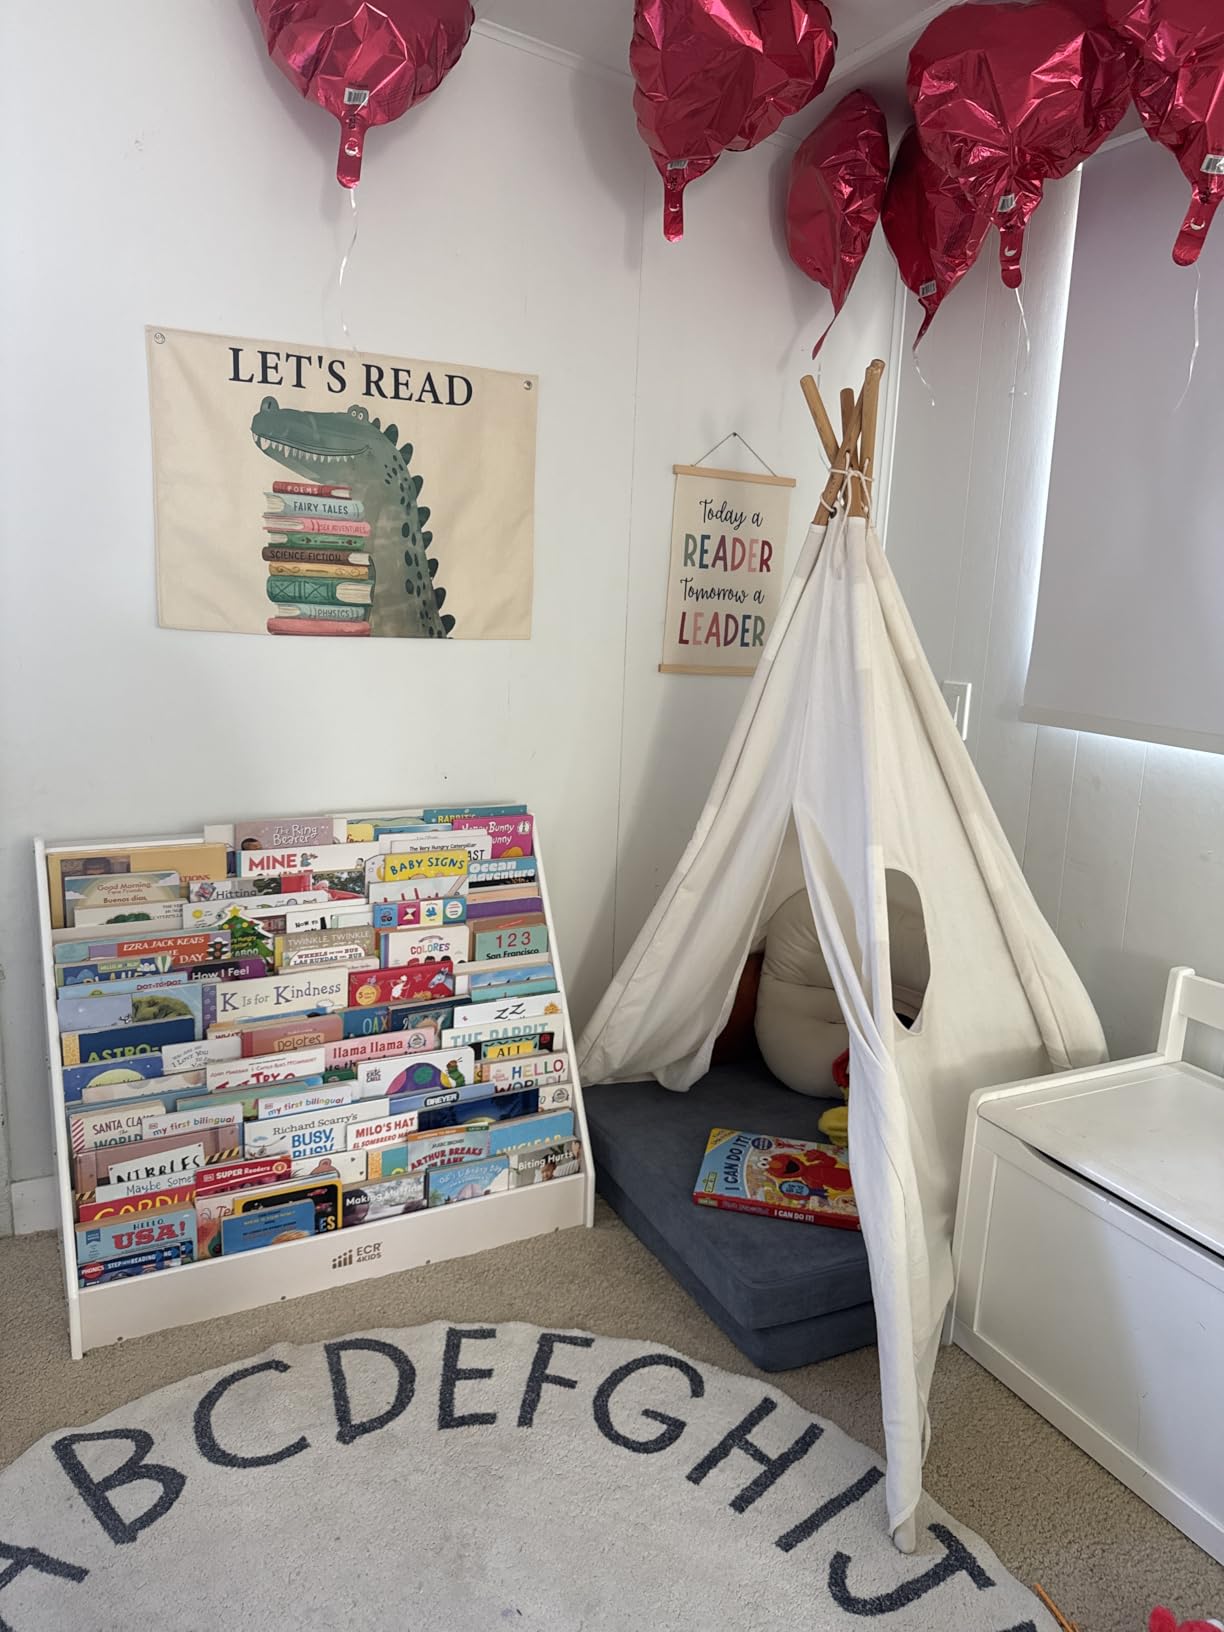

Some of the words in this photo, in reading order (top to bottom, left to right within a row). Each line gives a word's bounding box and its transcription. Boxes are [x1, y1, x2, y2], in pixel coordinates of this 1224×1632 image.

[228, 346, 347, 394] LET'S
[362, 363, 473, 407] READ
[287, 485, 319, 495] POEMS
[293, 500, 319, 513] FAIRY
[323, 503, 349, 515] TALES
[699, 498, 746, 530] Today
[751, 513, 763, 528] a
[270, 550, 306, 560] SCIENCE
[308, 552, 342, 562] FICTION
[683, 533, 773, 573] READER
[680, 577, 748, 604] Tomorrow
[754, 592, 765, 604] a
[317, 609, 350, 618] PHYSICS
[678, 611, 766, 648] LEADER
[291, 823, 318, 839] Ring
[488, 821, 515, 834] Bunny
[273, 834, 310, 846] Bearer
[248, 853, 297, 871] MINE
[467, 849, 485, 861] AST
[389, 857, 423, 876] BABY
[428, 856, 465, 869] SIGNS
[97, 883, 119, 892] Good
[216, 888, 257, 899] Hitting
[123, 942, 149, 951] EZRA
[150, 939, 175, 949] JACK
[176, 936, 205, 945] KEATS
[496, 934, 503, 949] 1
[507, 932, 517, 947] 2
[521, 931, 531, 946] 3
[297, 951, 328, 959] WHEELS
[410, 943, 451, 955] COLORES
[486, 952, 502, 960] San
[503, 948, 539, 958] Francisco
[179, 953, 205, 964] DAY
[192, 971, 219, 981] How
[221, 968, 225, 977] I
[228, 966, 250, 977] Feel
[220, 992, 240, 1012] K
[242, 996, 252, 1007] Is
[254, 994, 270, 1005] for
[273, 982, 341, 1005] Kindness
[362, 1015, 388, 1034] OAX
[333, 1045, 367, 1059] llama
[370, 1039, 404, 1053] llama
[512, 1059, 566, 1080] HELLO,
[268, 1106, 282, 1117] my
[284, 1100, 303, 1112] first
[305, 1097, 344, 1107] bilingual
[426, 1093, 458, 1106] BREYER
[92, 1119, 123, 1135] SANTA
[125, 1114, 155, 1128] CLA
[152, 1126, 167, 1136] my
[170, 1120, 191, 1132] first
[193, 1115, 235, 1128] bilingual
[272, 1120, 316, 1136] Richard
[317, 1112, 358, 1128] Scarry's
[355, 1123, 393, 1138] MILO'S
[394, 1117, 416, 1129] HAT
[291, 1128, 335, 1149] BUSY,
[361, 1134, 397, 1147] SOMBRERO
[732, 1135, 752, 1148] IT!
[410, 1149, 447, 1171] ARTHUR
[448, 1146, 484, 1156] BREAKS
[518, 1156, 546, 1171] Biting
[547, 1151, 574, 1164] Hurts
[726, 1147, 743, 1161] DO
[216, 1168, 243, 1180] SUPER
[723, 1162, 739, 1184] CAN
[126, 1181, 161, 1196] Maybe
[167, 1174, 195, 1187] Some
[345, 1193, 383, 1207] Making
[778, 1210, 794, 1219] CAN
[133, 1218, 164, 1230] HELLO
[319, 1215, 336, 1232] ES
[112, 1221, 186, 1250] USA!
[356, 1242, 382, 1256] ECR
[81, 1264, 105, 1275] PHONICS
[131, 1254, 156, 1264] READING
[356, 1252, 382, 1263] 4KIDS
